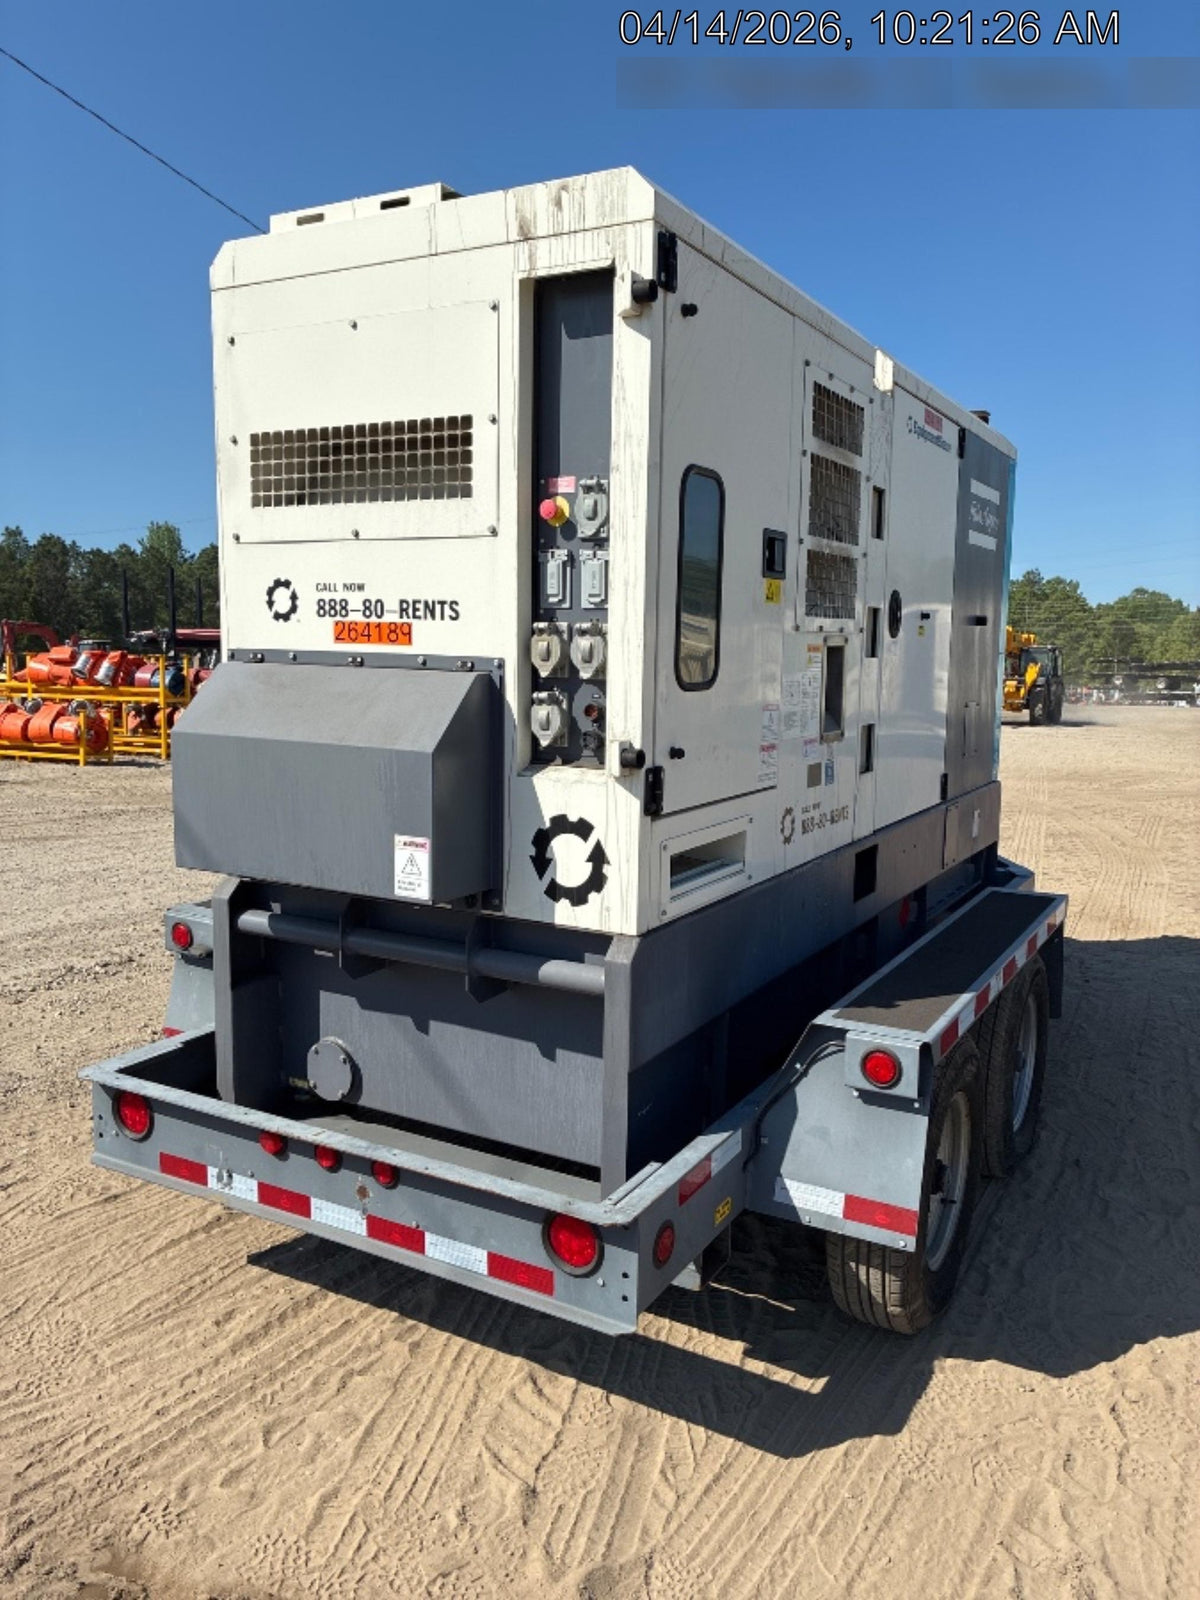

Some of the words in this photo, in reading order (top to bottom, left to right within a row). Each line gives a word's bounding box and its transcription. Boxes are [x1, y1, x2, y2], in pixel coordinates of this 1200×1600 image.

[315, 583, 338, 592] CALL
[342, 583, 365, 592] NOW
[316, 598, 460, 621] 888-80-RENTS
[334, 620, 412, 643] 264189
